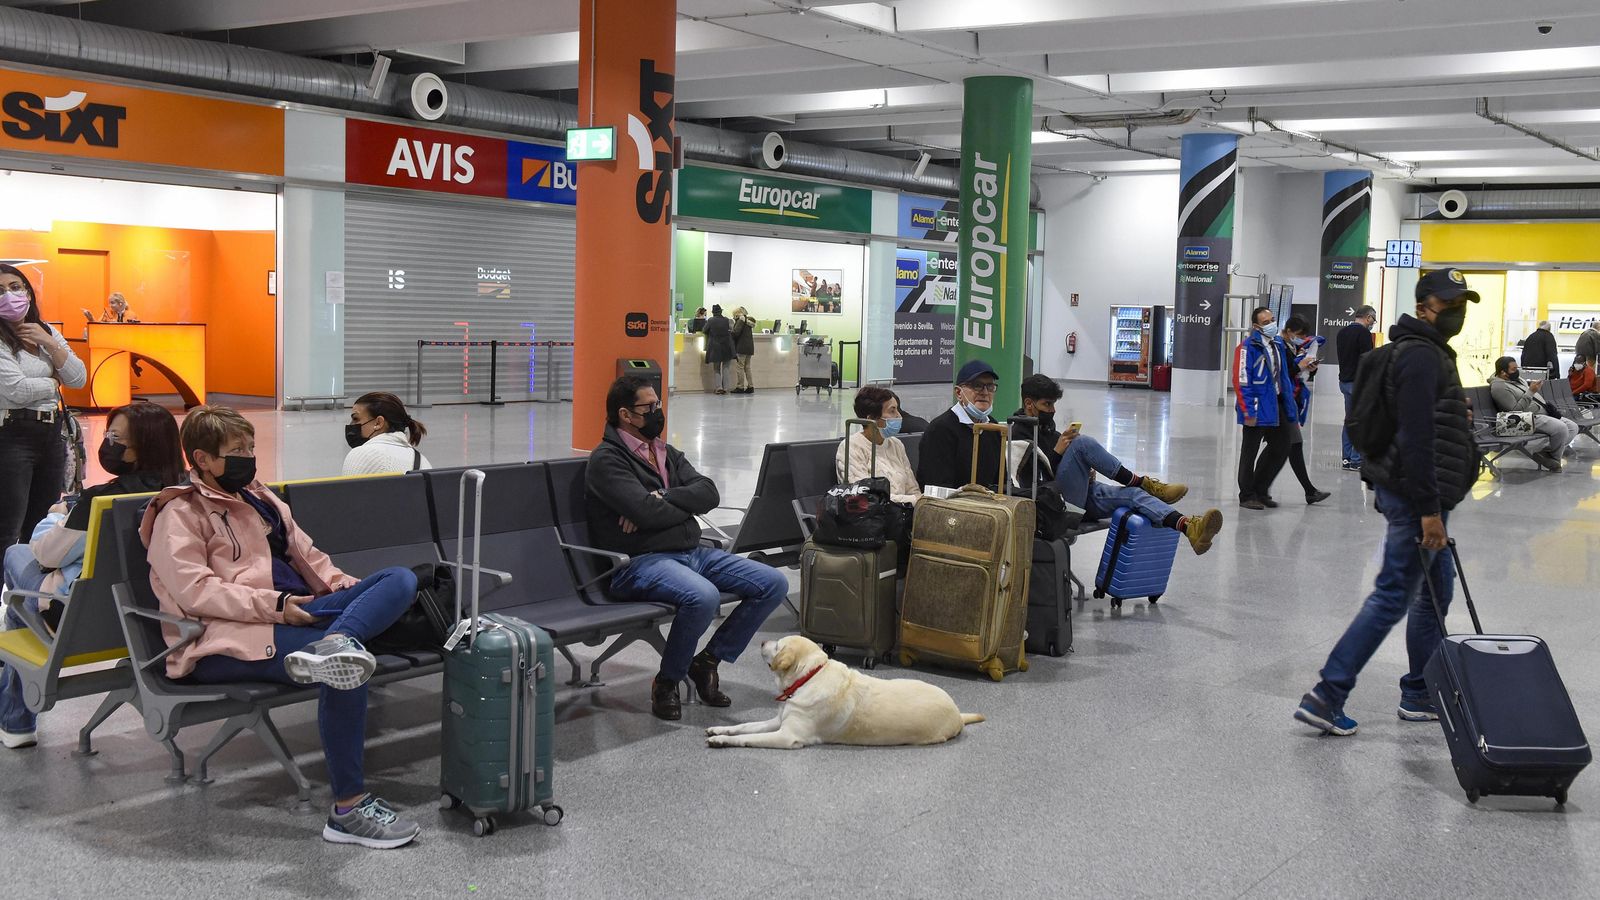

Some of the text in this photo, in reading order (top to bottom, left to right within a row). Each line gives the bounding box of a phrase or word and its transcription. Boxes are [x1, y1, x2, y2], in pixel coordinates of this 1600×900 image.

[2, 91, 126, 148] SIXT
[627, 59, 674, 225] SIXT
[386, 137, 475, 184] AVIS
[553, 162, 577, 190] Bu
[738, 177, 820, 215] Europcar
[912, 213, 935, 224] Alamo
[940, 216, 959, 227] ente
[963, 151, 1007, 349] Europcar
[930, 256, 957, 270] enter
[1177, 262, 1219, 270] enterprise
[477, 266, 511, 284] Budget
[896, 266, 918, 280] lamo
[1185, 275, 1213, 283] National
[943, 287, 957, 301] Nat
[894, 322, 912, 330] nvenido
[1176, 313, 1211, 326] Parking
[1323, 318, 1353, 327] Parkin
[1559, 316, 1600, 329] Hert
